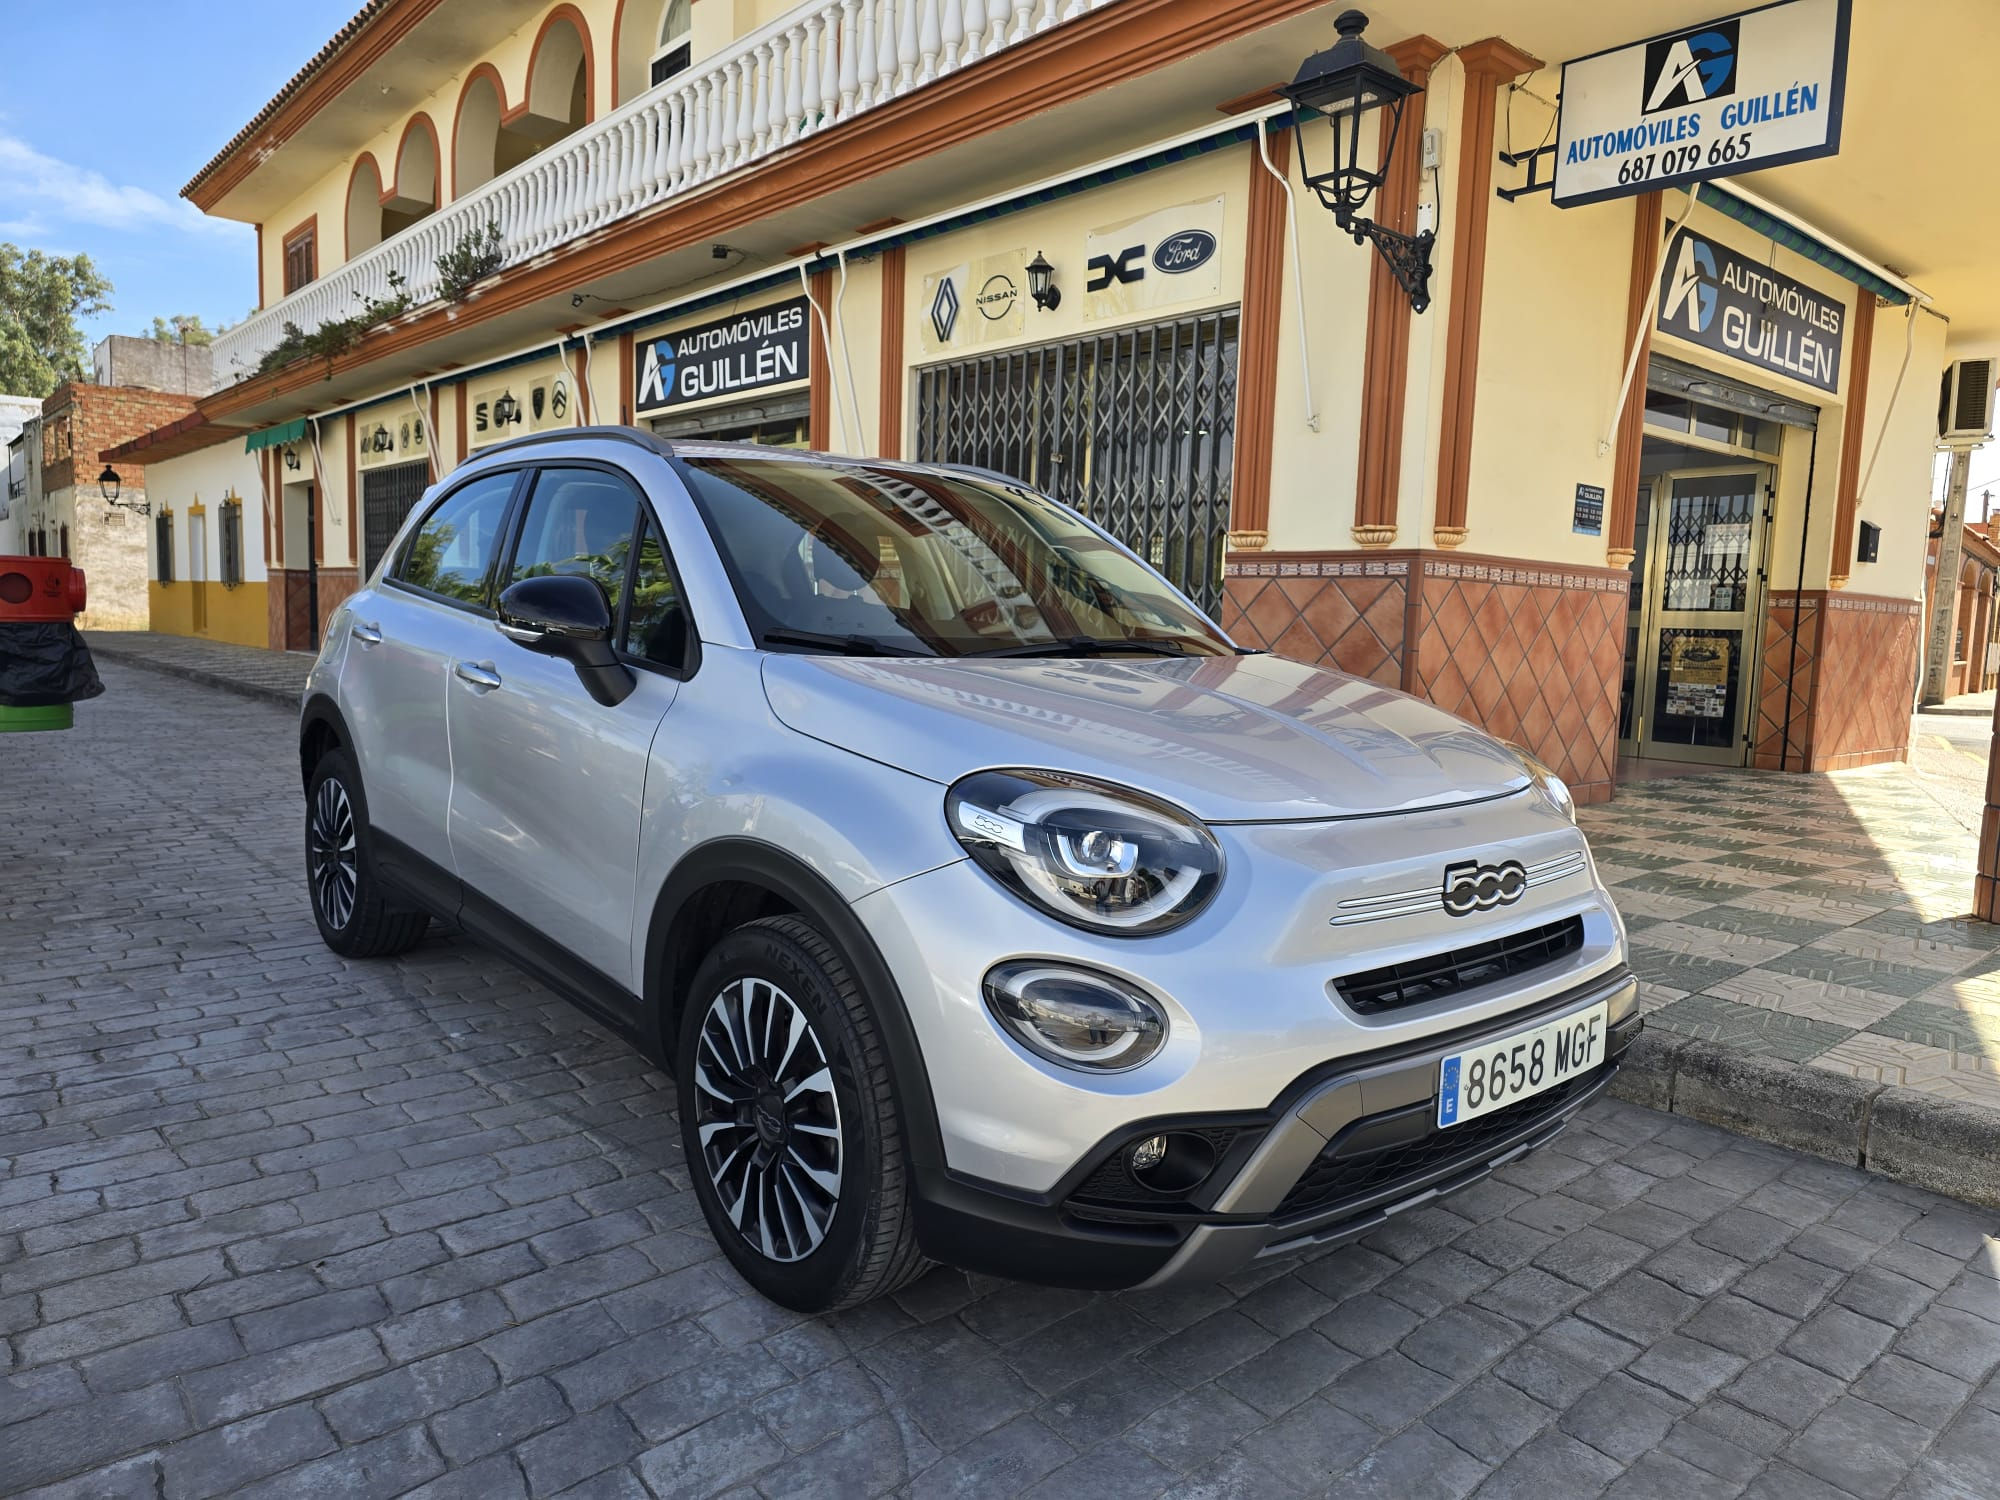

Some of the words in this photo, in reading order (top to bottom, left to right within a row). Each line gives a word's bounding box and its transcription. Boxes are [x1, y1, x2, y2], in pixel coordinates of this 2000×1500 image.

[1566, 113, 1701, 165] AUTOMÓVILES
[1720, 81, 1819, 130] GUILLÉN
[1618, 152, 1655, 184] 687
[1662, 145, 1701, 175] 079
[1708, 132, 1752, 166] 665
[1165, 237, 1202, 266] Ford
[976, 289, 1017, 305] NISSAN
[1722, 262, 1839, 334] AUTOMÓVILES
[677, 306, 802, 358] AUTOMÓVILES
[1722, 305, 1833, 384] GUILLÉN
[681, 340, 798, 397] GUILLÉN
[975, 814, 1004, 834] 500
[1442, 861, 1526, 915] 500
[766, 943, 828, 1016] NEXEN
[1467, 1038, 1545, 1109] 8658
[1554, 1014, 1601, 1077] MGF
[1445, 1098, 1454, 1113] E
